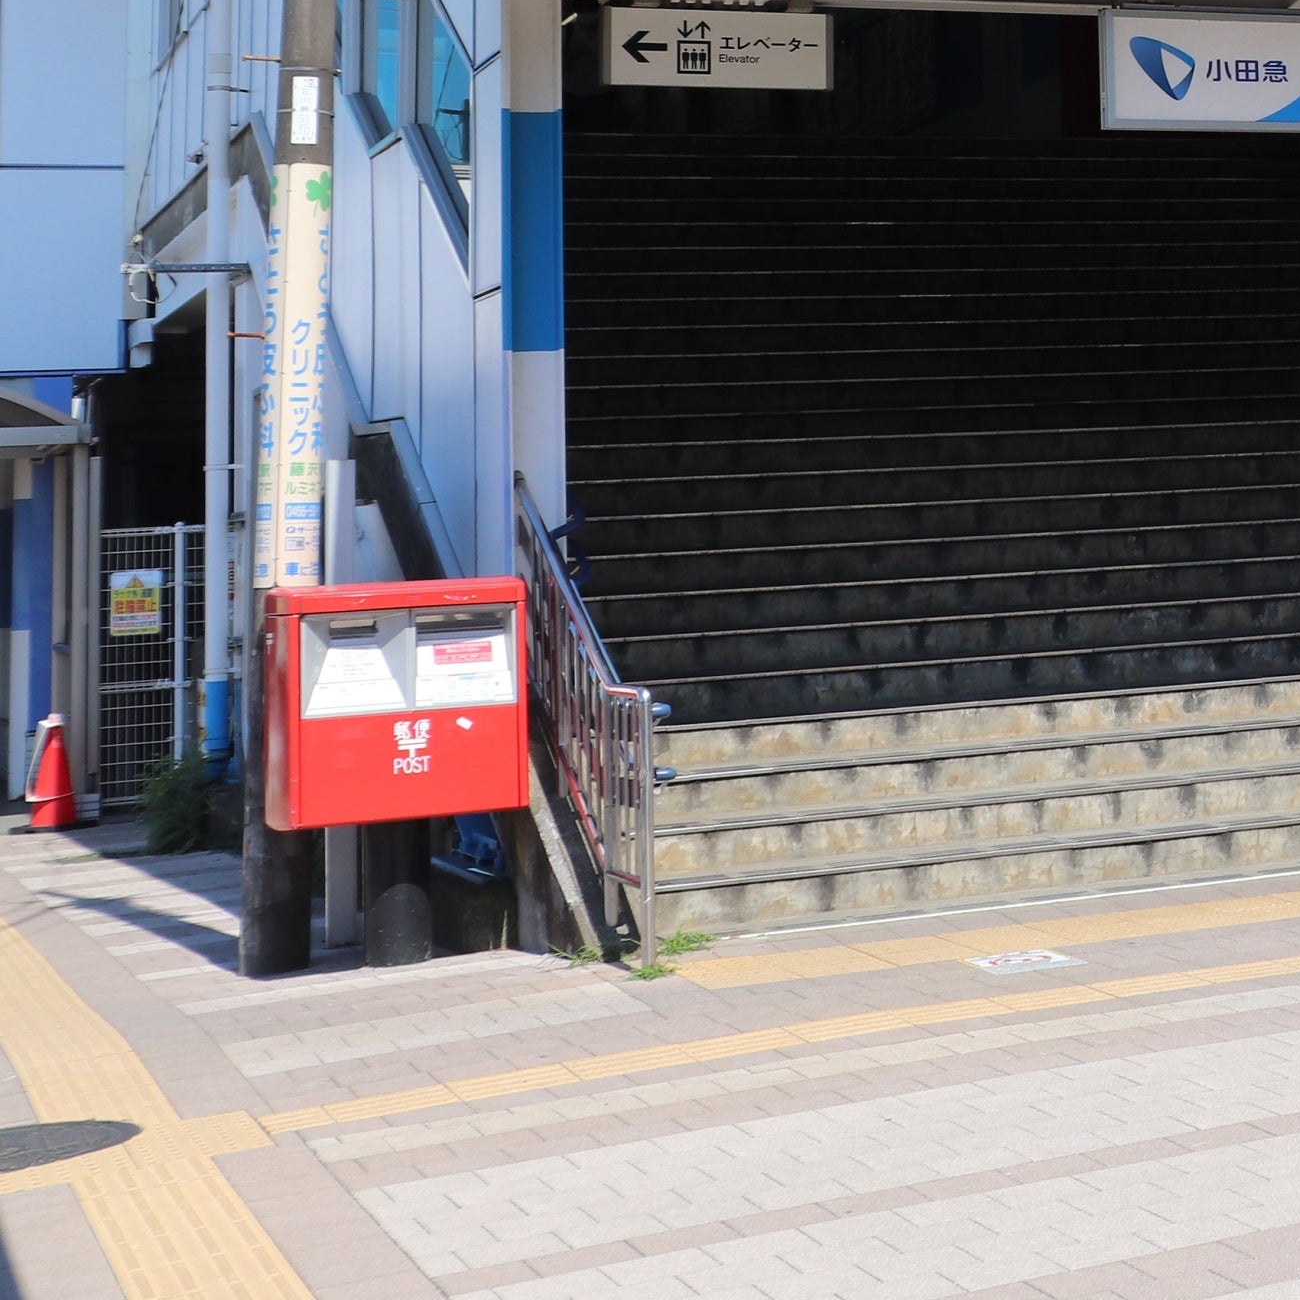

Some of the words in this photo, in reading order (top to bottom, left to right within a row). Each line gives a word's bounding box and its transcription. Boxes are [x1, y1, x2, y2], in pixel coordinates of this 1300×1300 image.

[719, 35, 819, 53] エレベーター
[718, 53, 760, 65] Elevator
[1205, 58, 1289, 84] 小田急
[288, 318, 311, 456] クリニック
[393, 718, 431, 741] 郵便
[393, 756, 431, 775] POST
